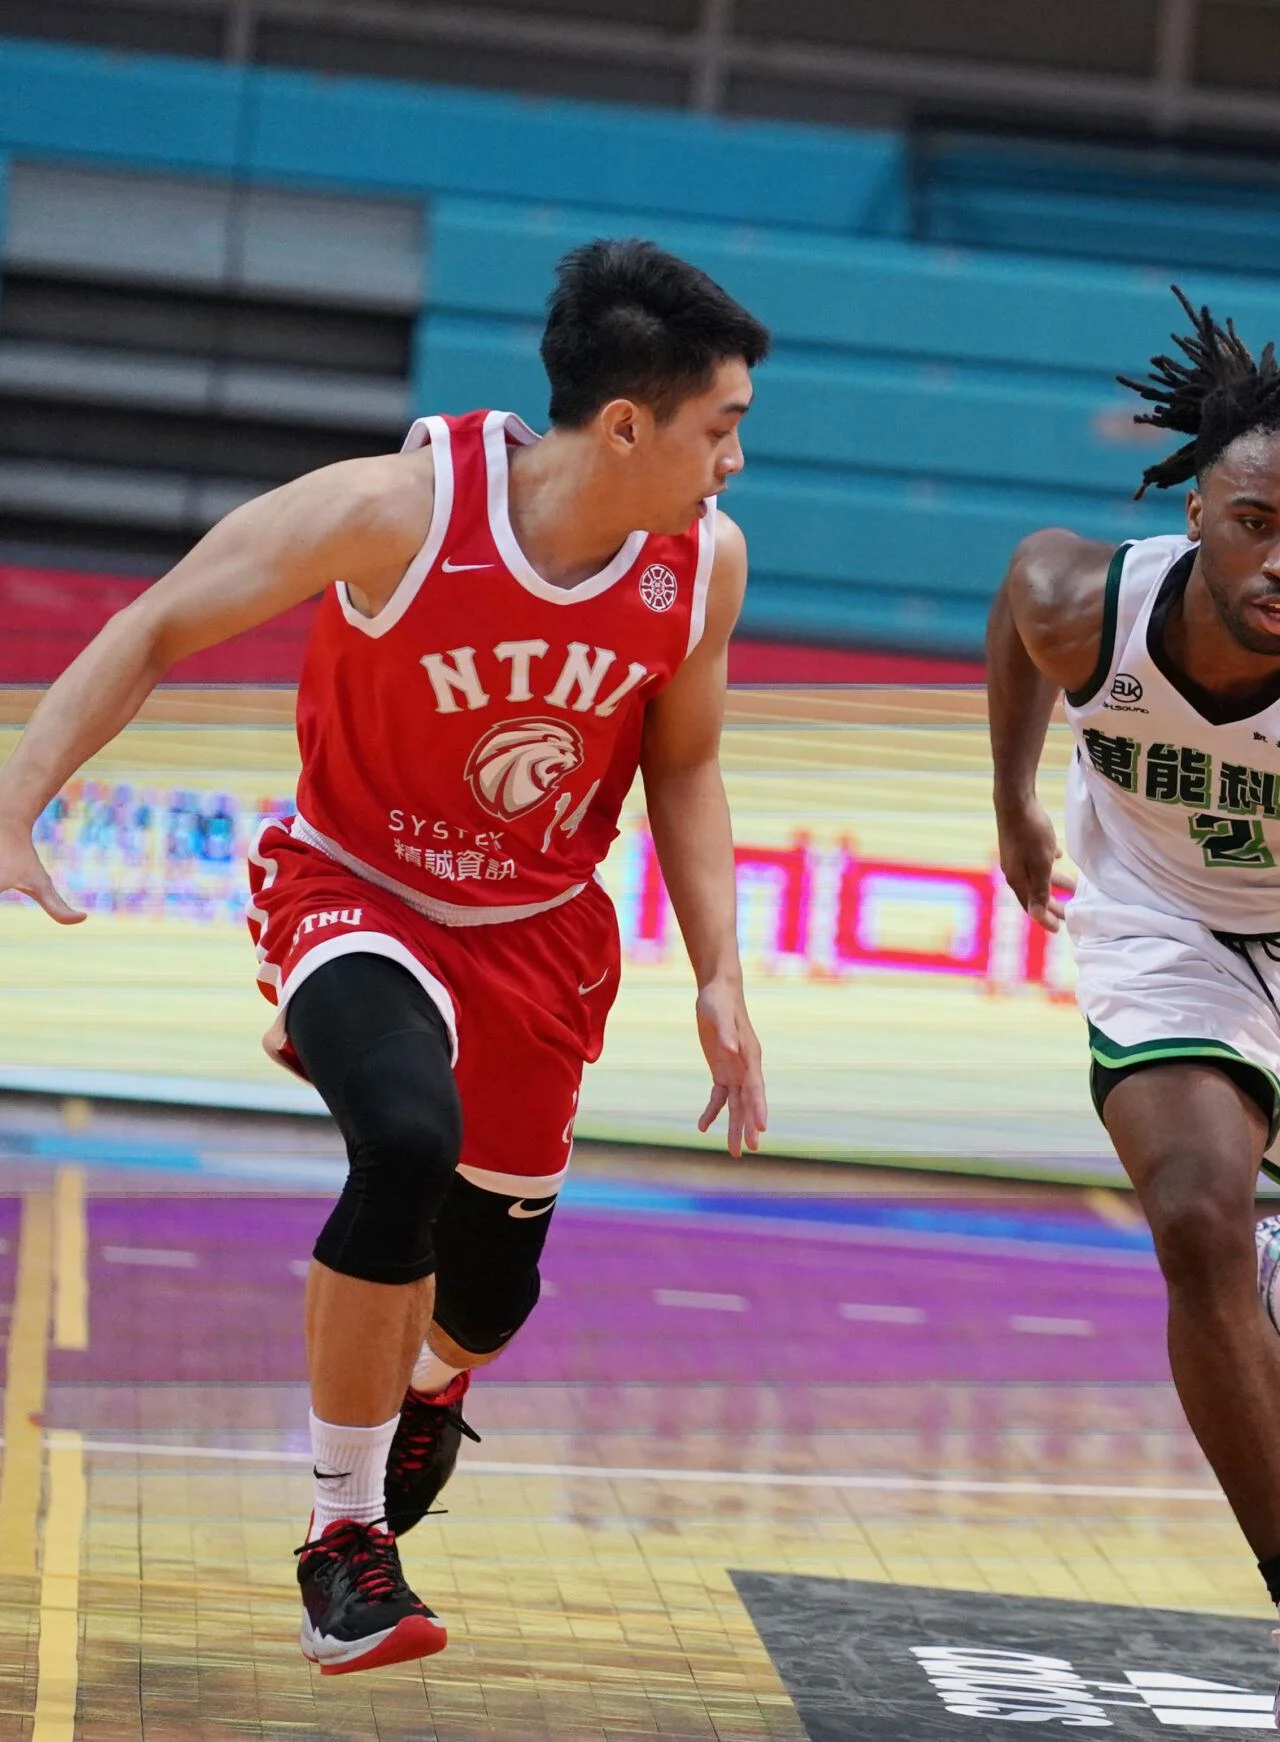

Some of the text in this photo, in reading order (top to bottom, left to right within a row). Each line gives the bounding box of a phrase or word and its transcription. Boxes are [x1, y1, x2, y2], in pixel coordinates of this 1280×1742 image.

[392, 837, 518, 882] 精誠資訊
[1187, 811, 1279, 869] 2
